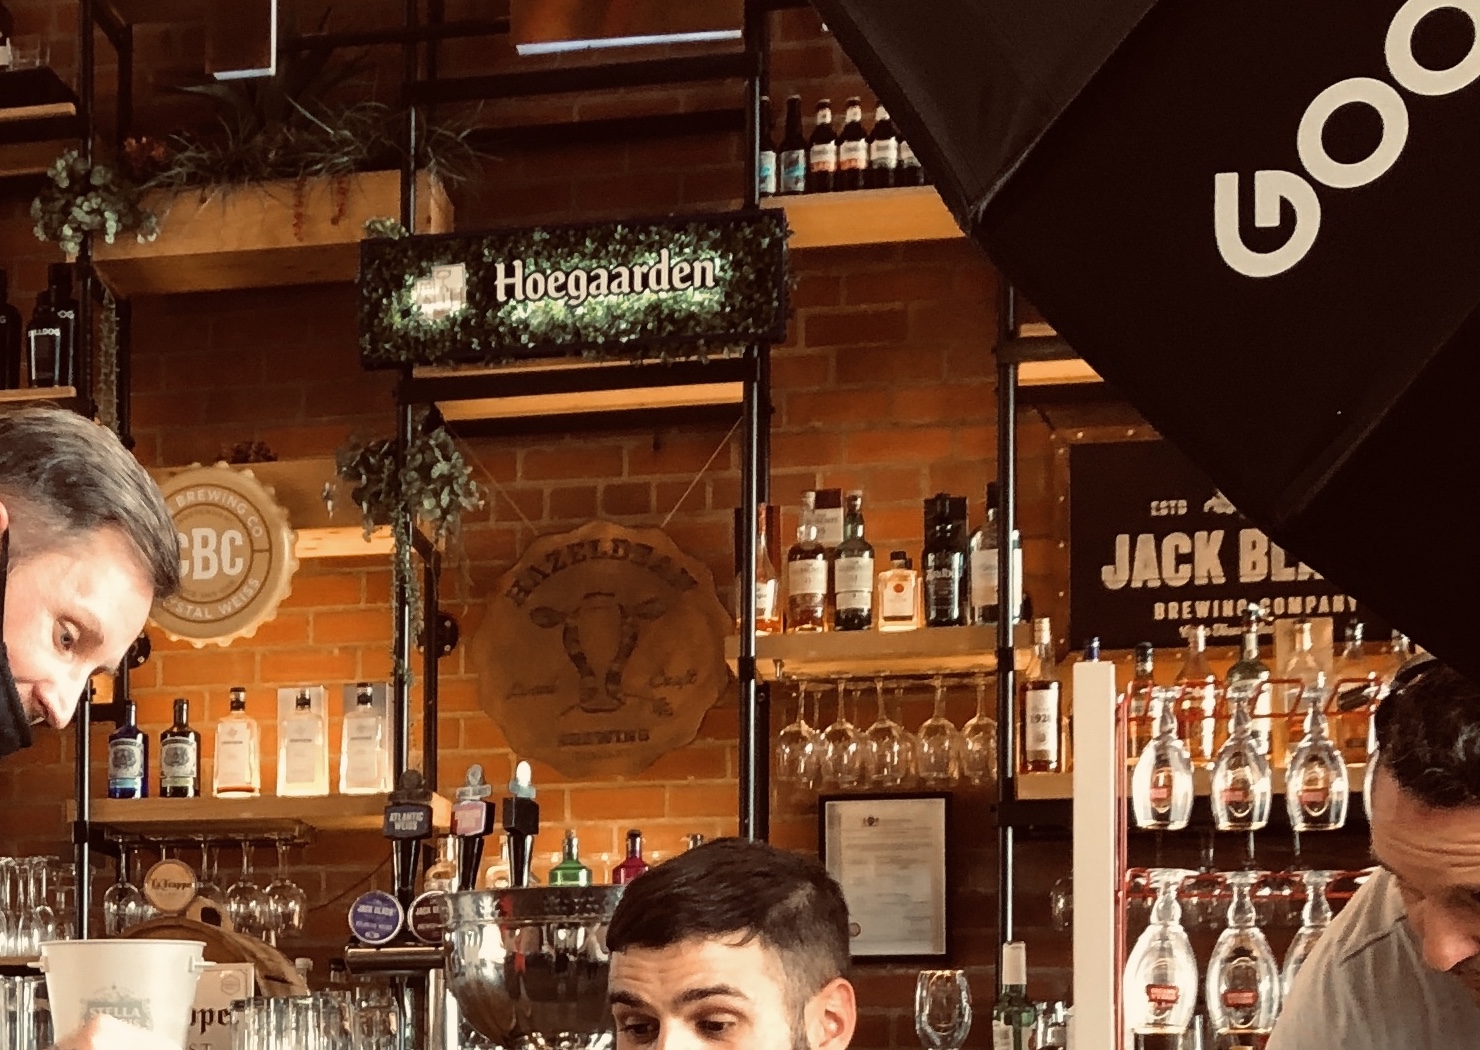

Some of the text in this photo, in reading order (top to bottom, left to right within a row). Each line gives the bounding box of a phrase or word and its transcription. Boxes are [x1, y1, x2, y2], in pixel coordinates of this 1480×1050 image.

[493, 248, 717, 307] Hoegaarden
[175, 489, 248, 515] BREWING
[246, 516, 263, 538] CO
[1150, 499, 1188, 517] ESTD
[1100, 529, 1227, 591] JACK
[217, 577, 261, 615] WEISS
[1153, 594, 1358, 621] BREWING COMPANY
[88, 1006, 142, 1019] STELLA
